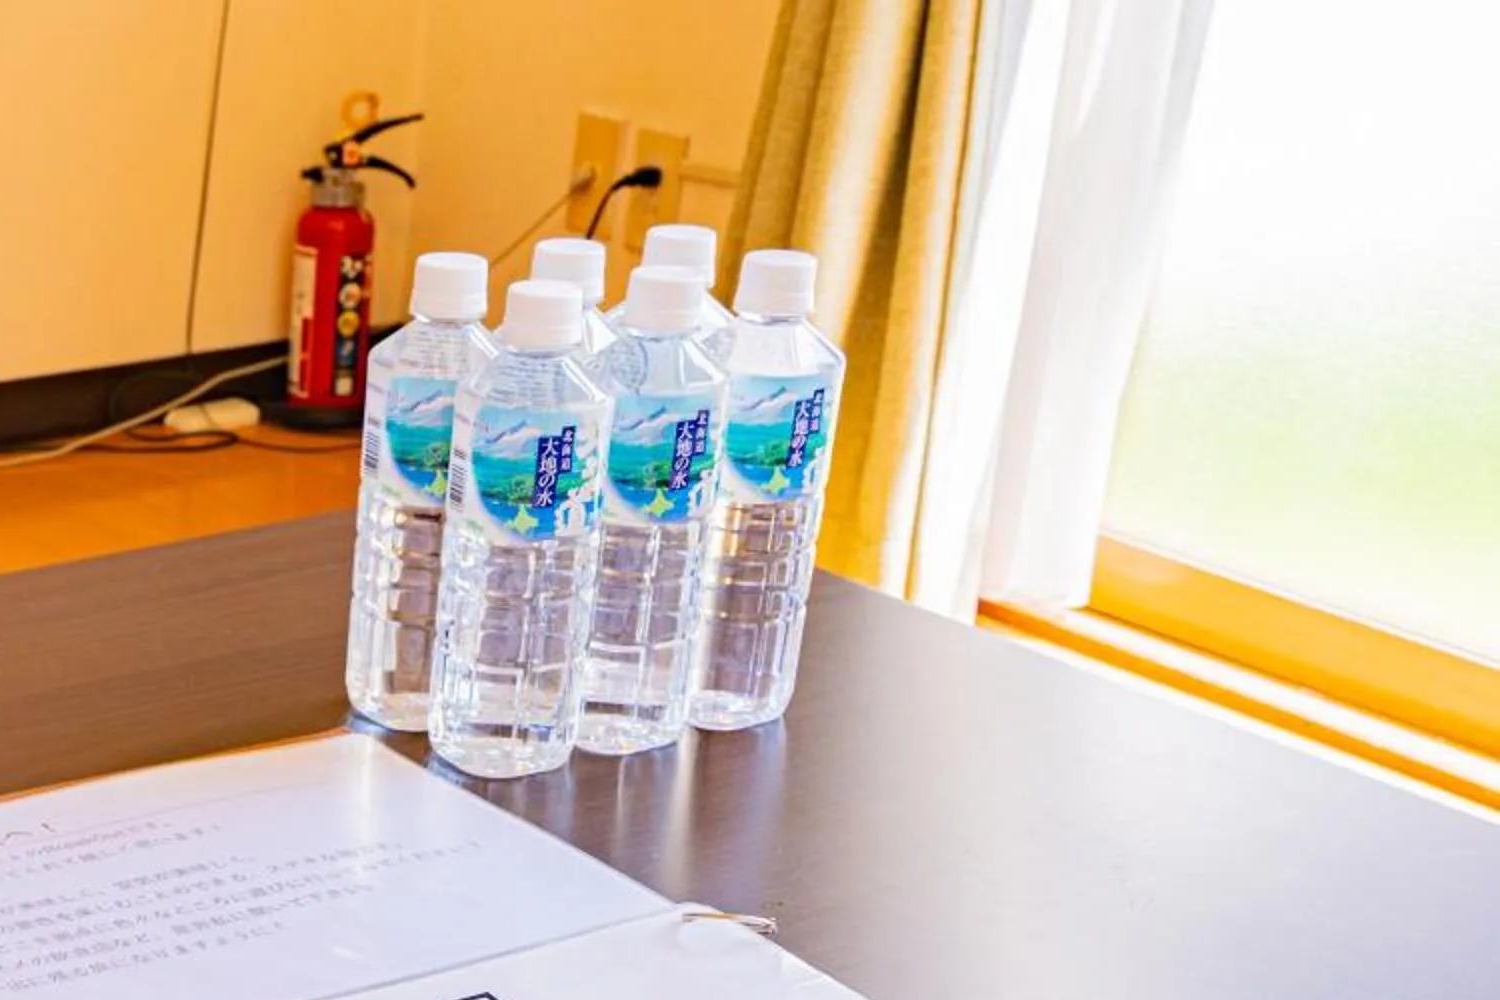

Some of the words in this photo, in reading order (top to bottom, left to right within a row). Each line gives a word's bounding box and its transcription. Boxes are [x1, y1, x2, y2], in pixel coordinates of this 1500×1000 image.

[671, 421, 695, 490] 大地の水
[787, 400, 811, 467] 大地の水
[535, 437, 559, 506] 大地の水
